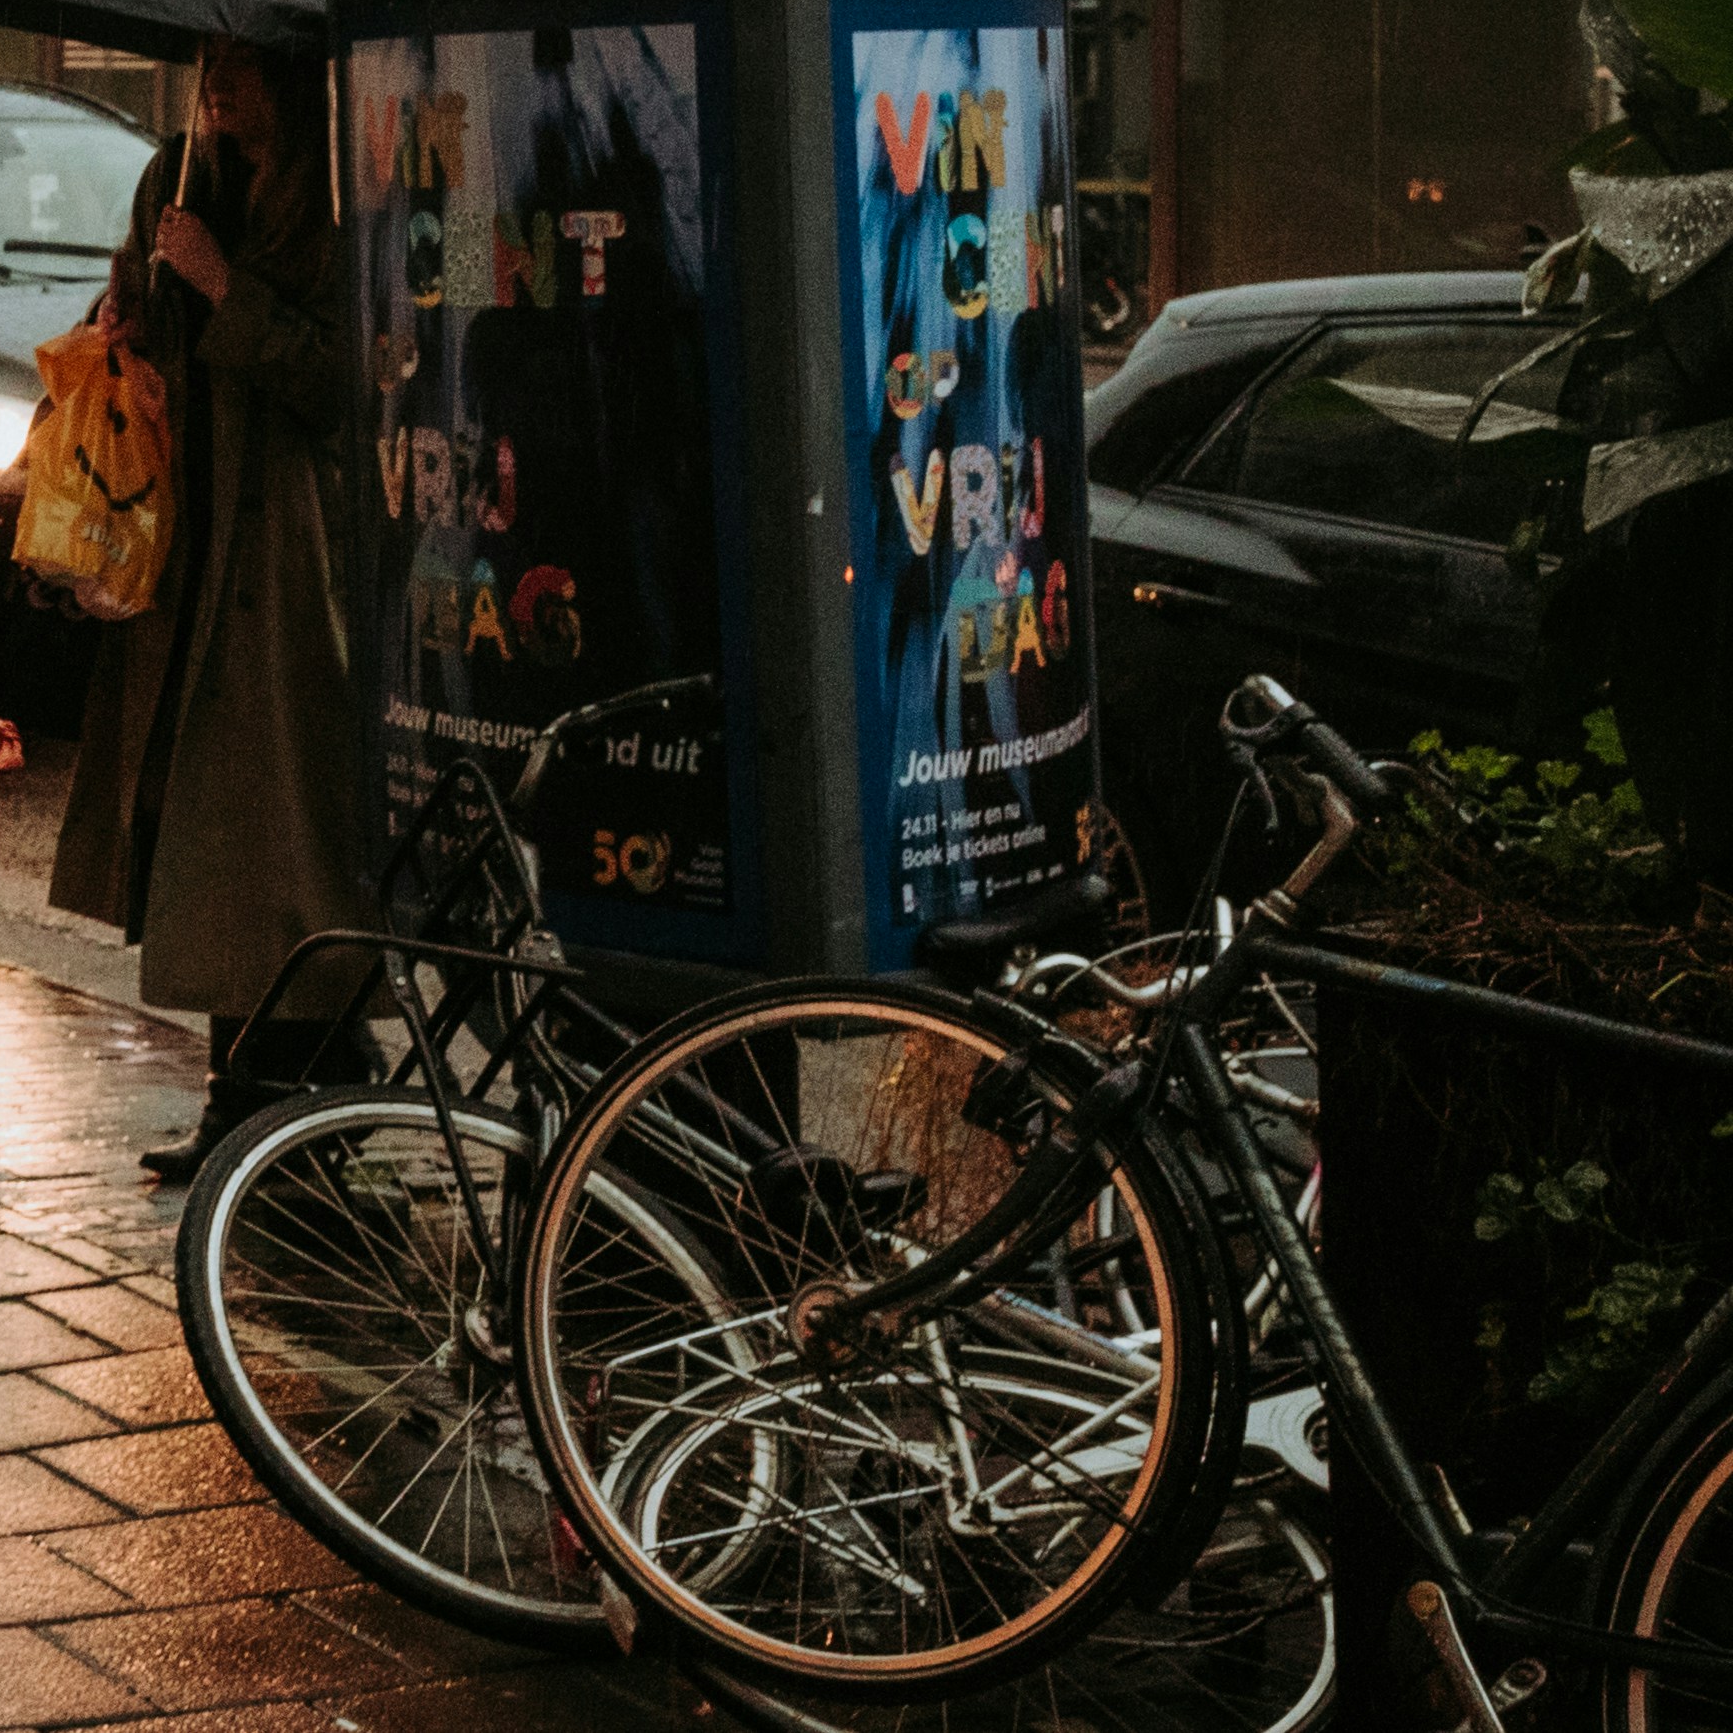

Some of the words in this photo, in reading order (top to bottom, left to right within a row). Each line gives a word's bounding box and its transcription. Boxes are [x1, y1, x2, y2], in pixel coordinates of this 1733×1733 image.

[651, 737, 702, 776] uit
[899, 748, 972, 787] Jouw
[902, 845, 943, 870] Boek
